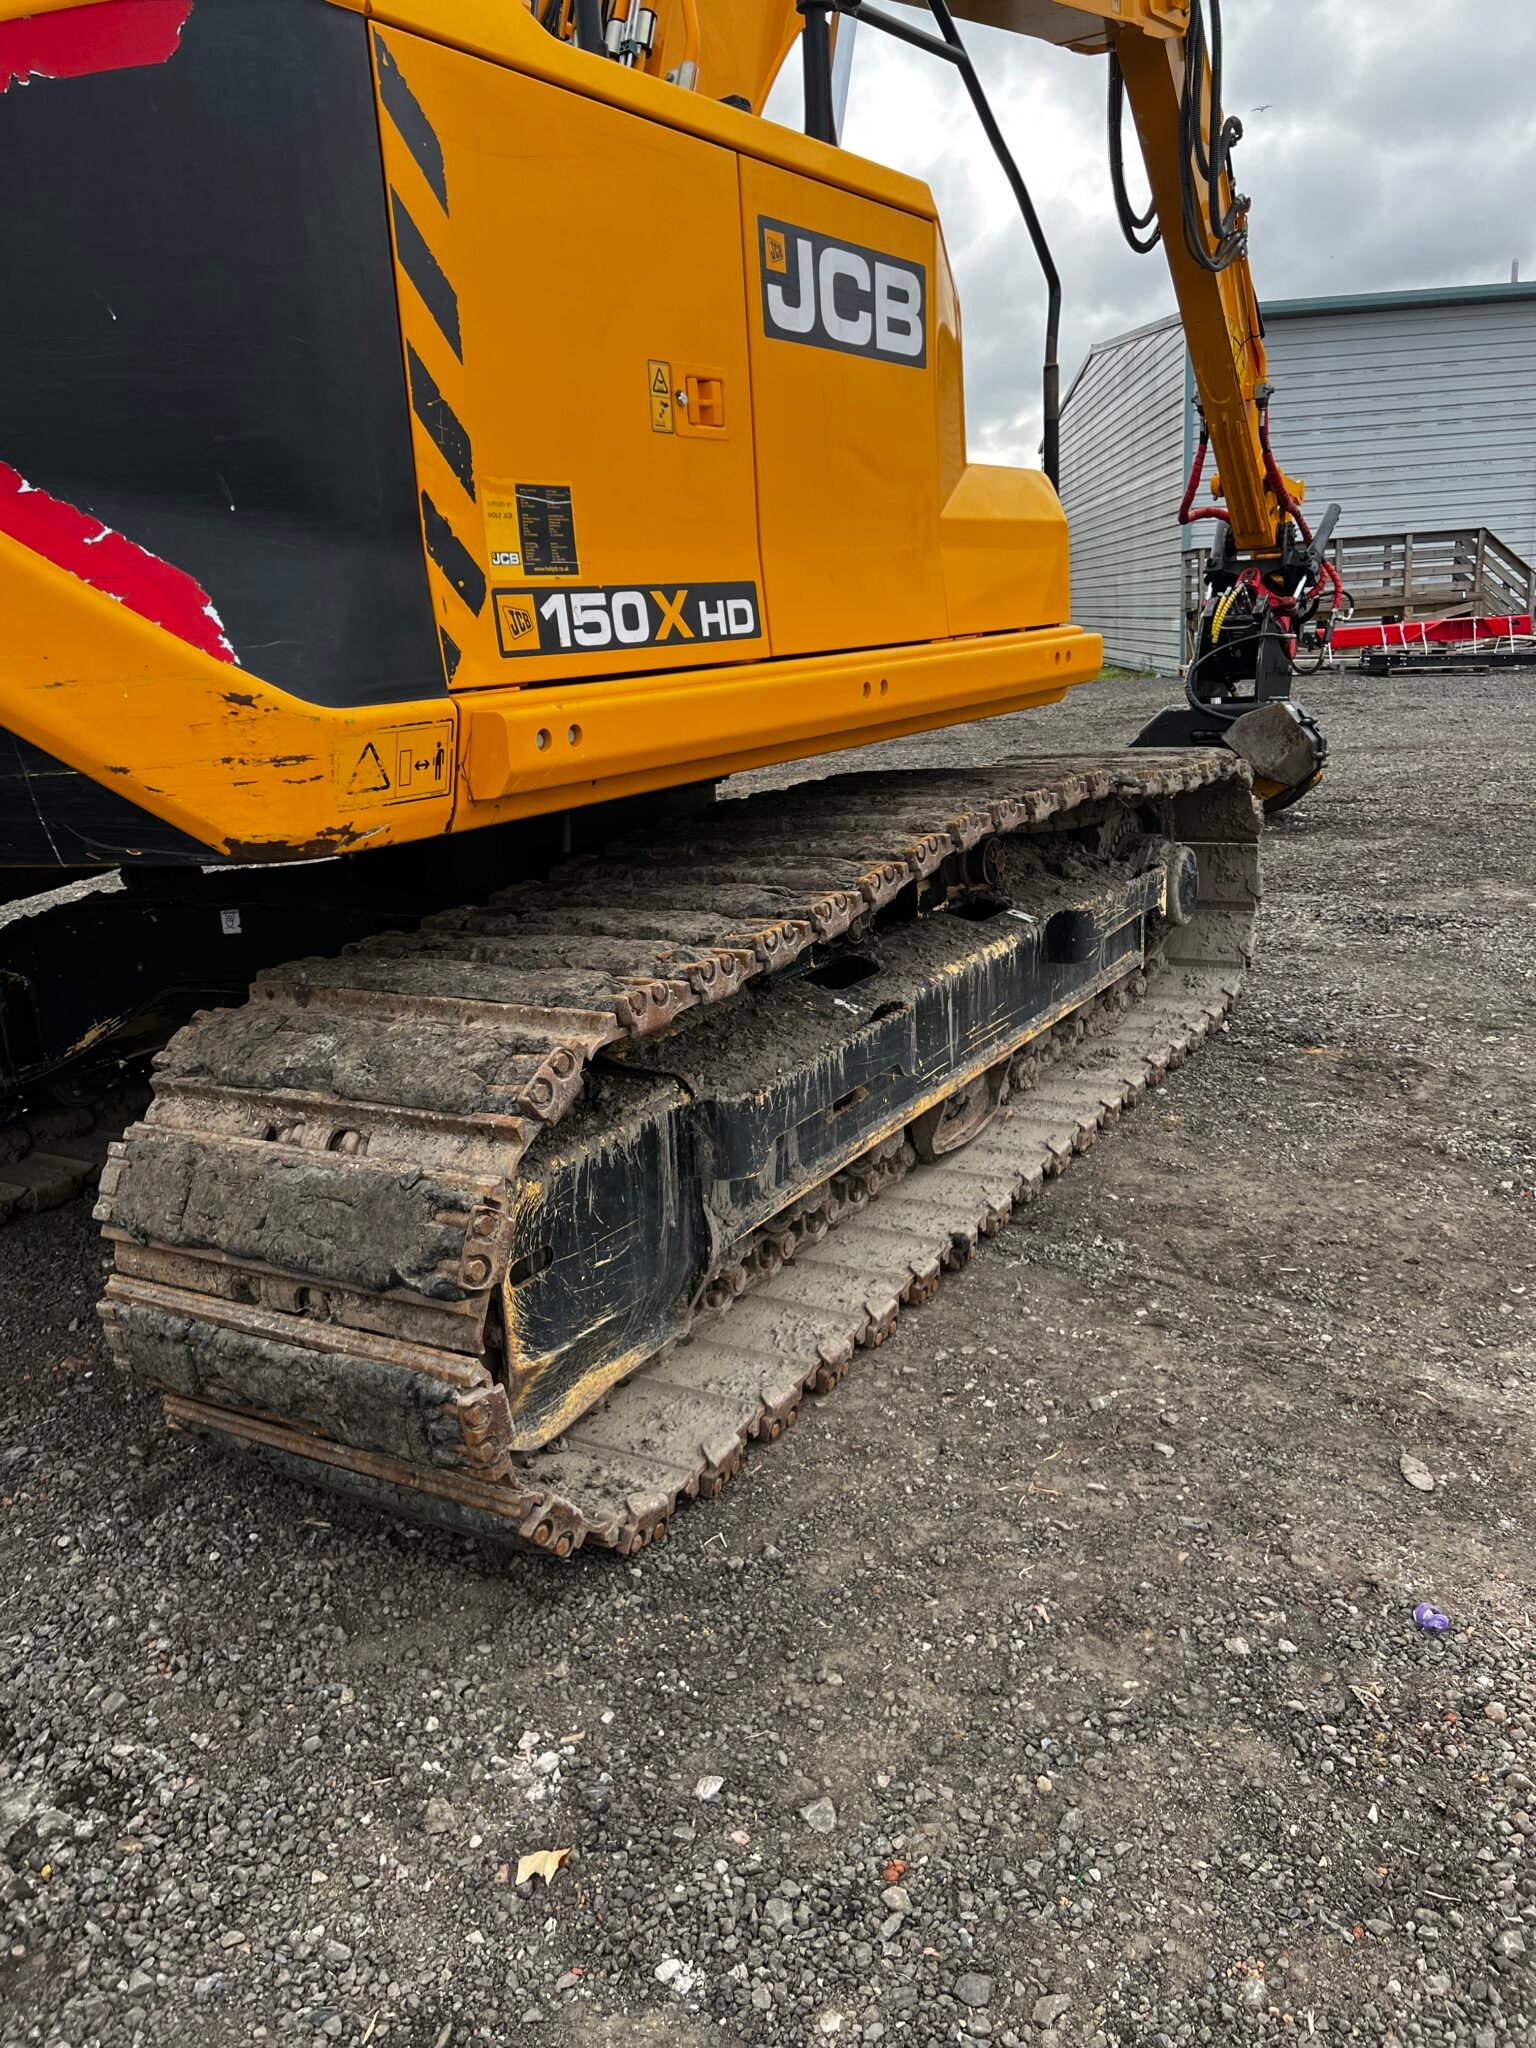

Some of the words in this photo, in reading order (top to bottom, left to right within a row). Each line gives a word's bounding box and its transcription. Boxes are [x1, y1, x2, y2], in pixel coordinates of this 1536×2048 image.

[767, 238, 923, 357] JCB
[492, 552, 520, 565] JCB
[508, 609, 532, 636] JCB
[698, 598, 755, 638] HD
